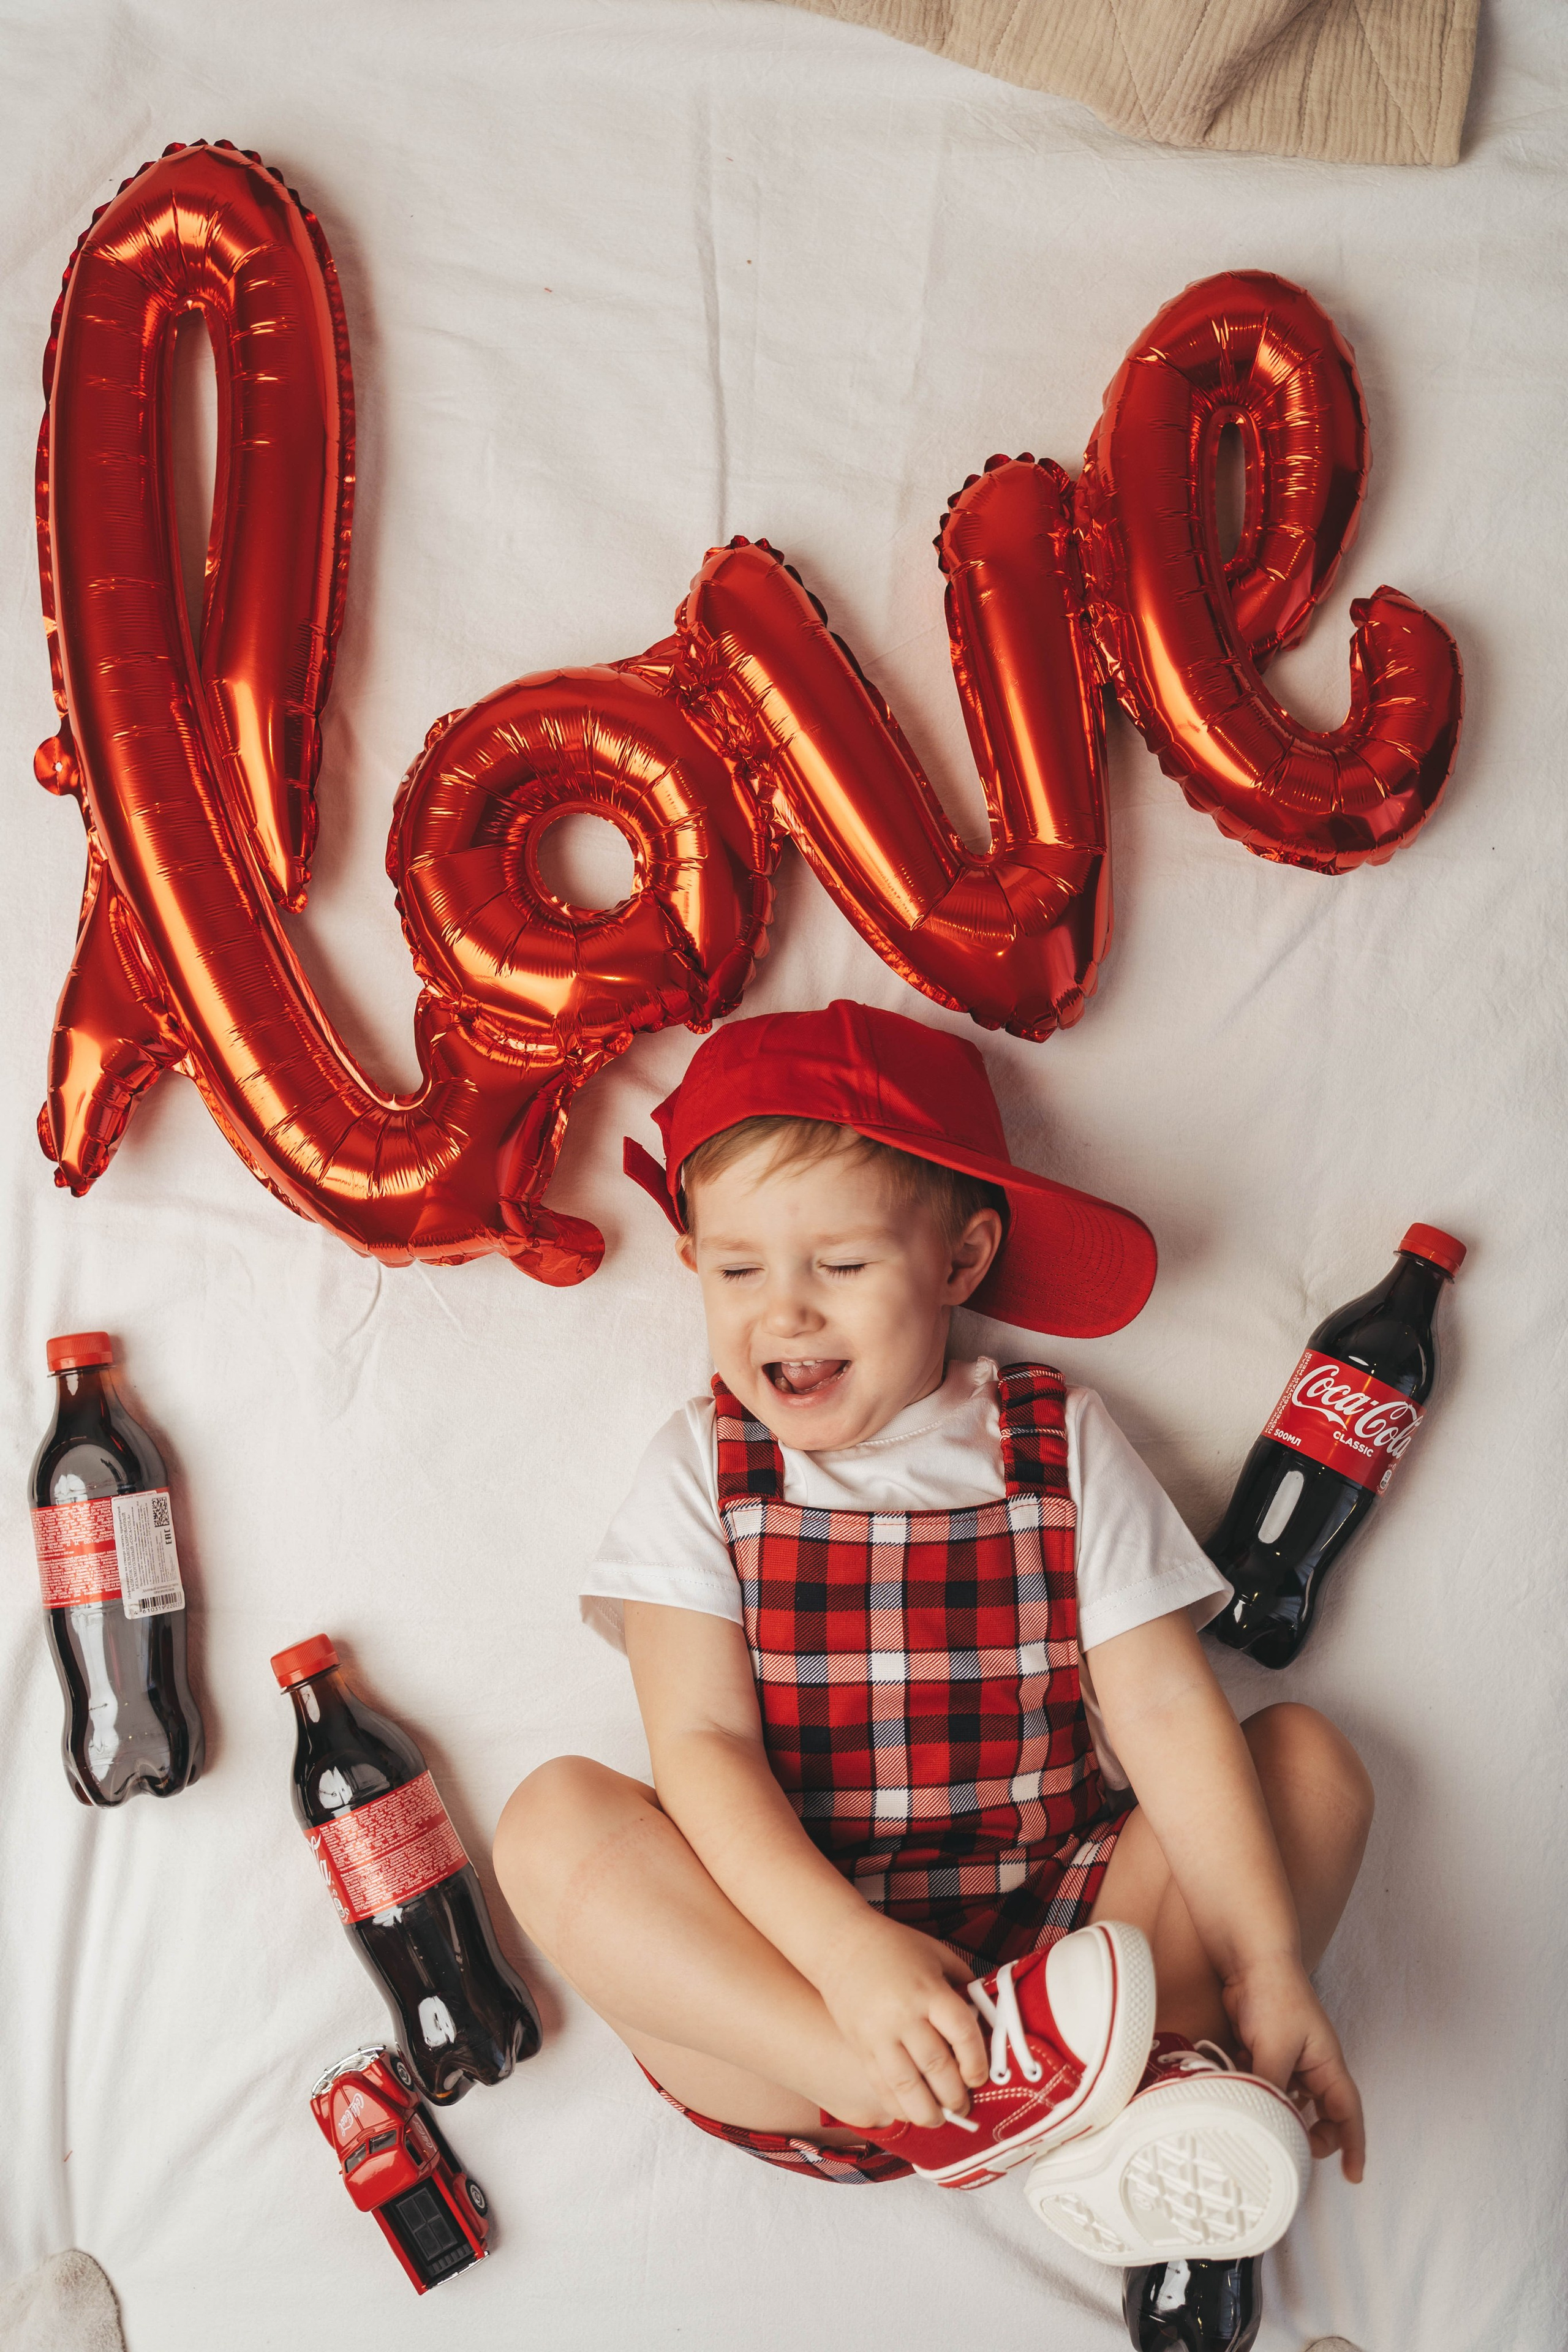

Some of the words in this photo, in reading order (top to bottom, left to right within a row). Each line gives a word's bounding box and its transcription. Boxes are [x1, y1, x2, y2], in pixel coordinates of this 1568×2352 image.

[1267, 1376, 1300, 1434] ПЕРЕРАБОТАЙ
[1298, 1352, 1313, 1379] МЕНЯ
[1292, 1364, 1424, 1460] Coca-Cola
[1333, 1431, 1374, 1458] CLASSIC
